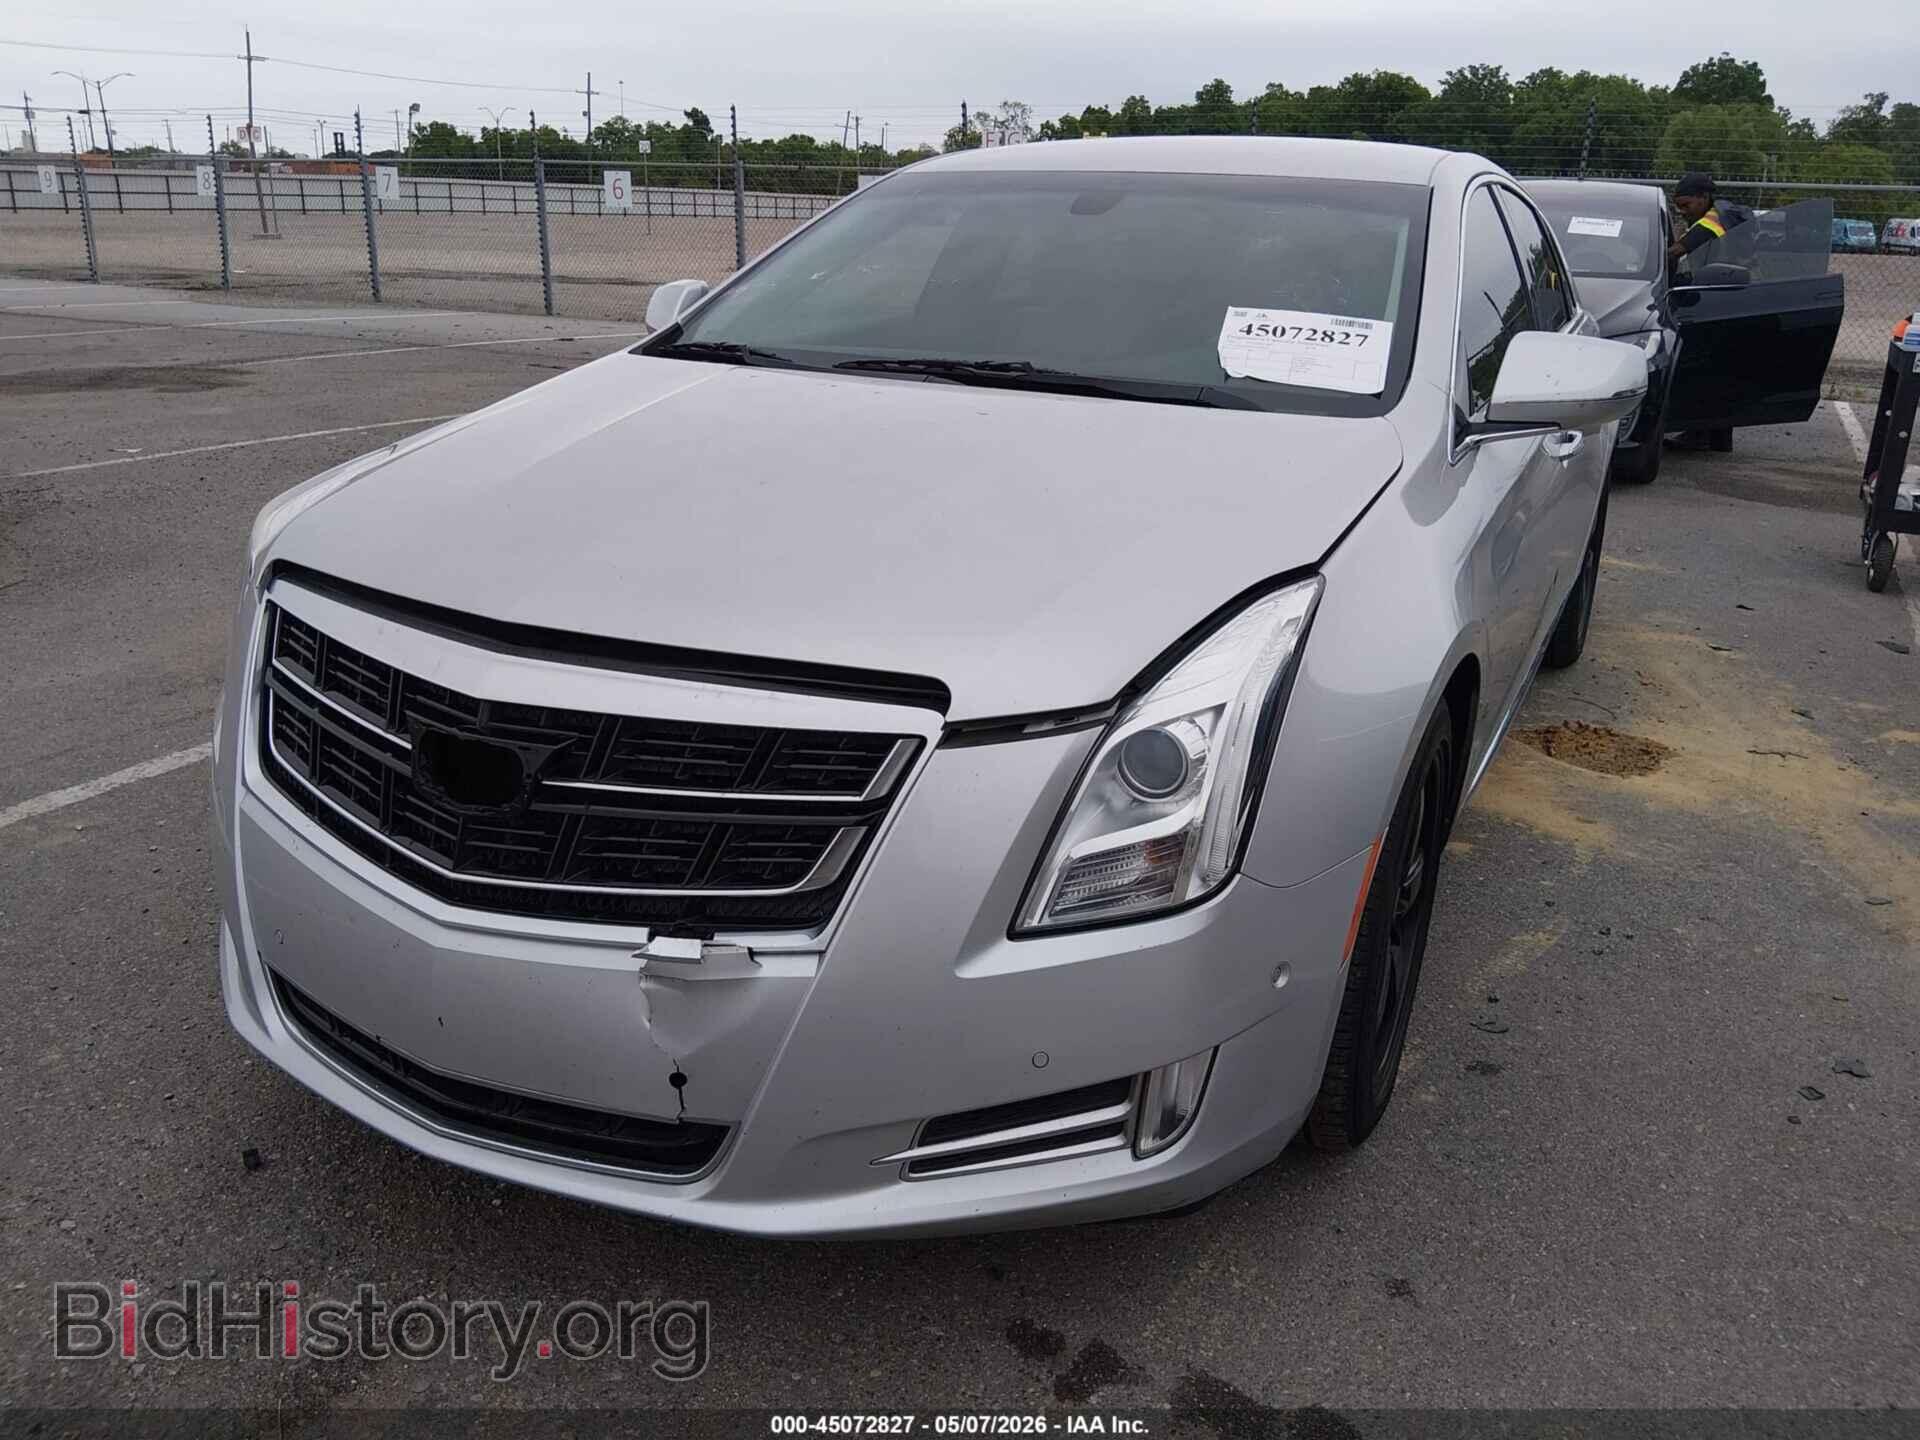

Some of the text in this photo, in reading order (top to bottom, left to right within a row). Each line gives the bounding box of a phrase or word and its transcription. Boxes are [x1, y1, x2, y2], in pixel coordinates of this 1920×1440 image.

[43, 170, 52, 188] 9
[202, 172, 212, 190] 8
[382, 173, 392, 193] 7
[612, 178, 624, 200] 6
[1238, 323, 1369, 347] 45072827
